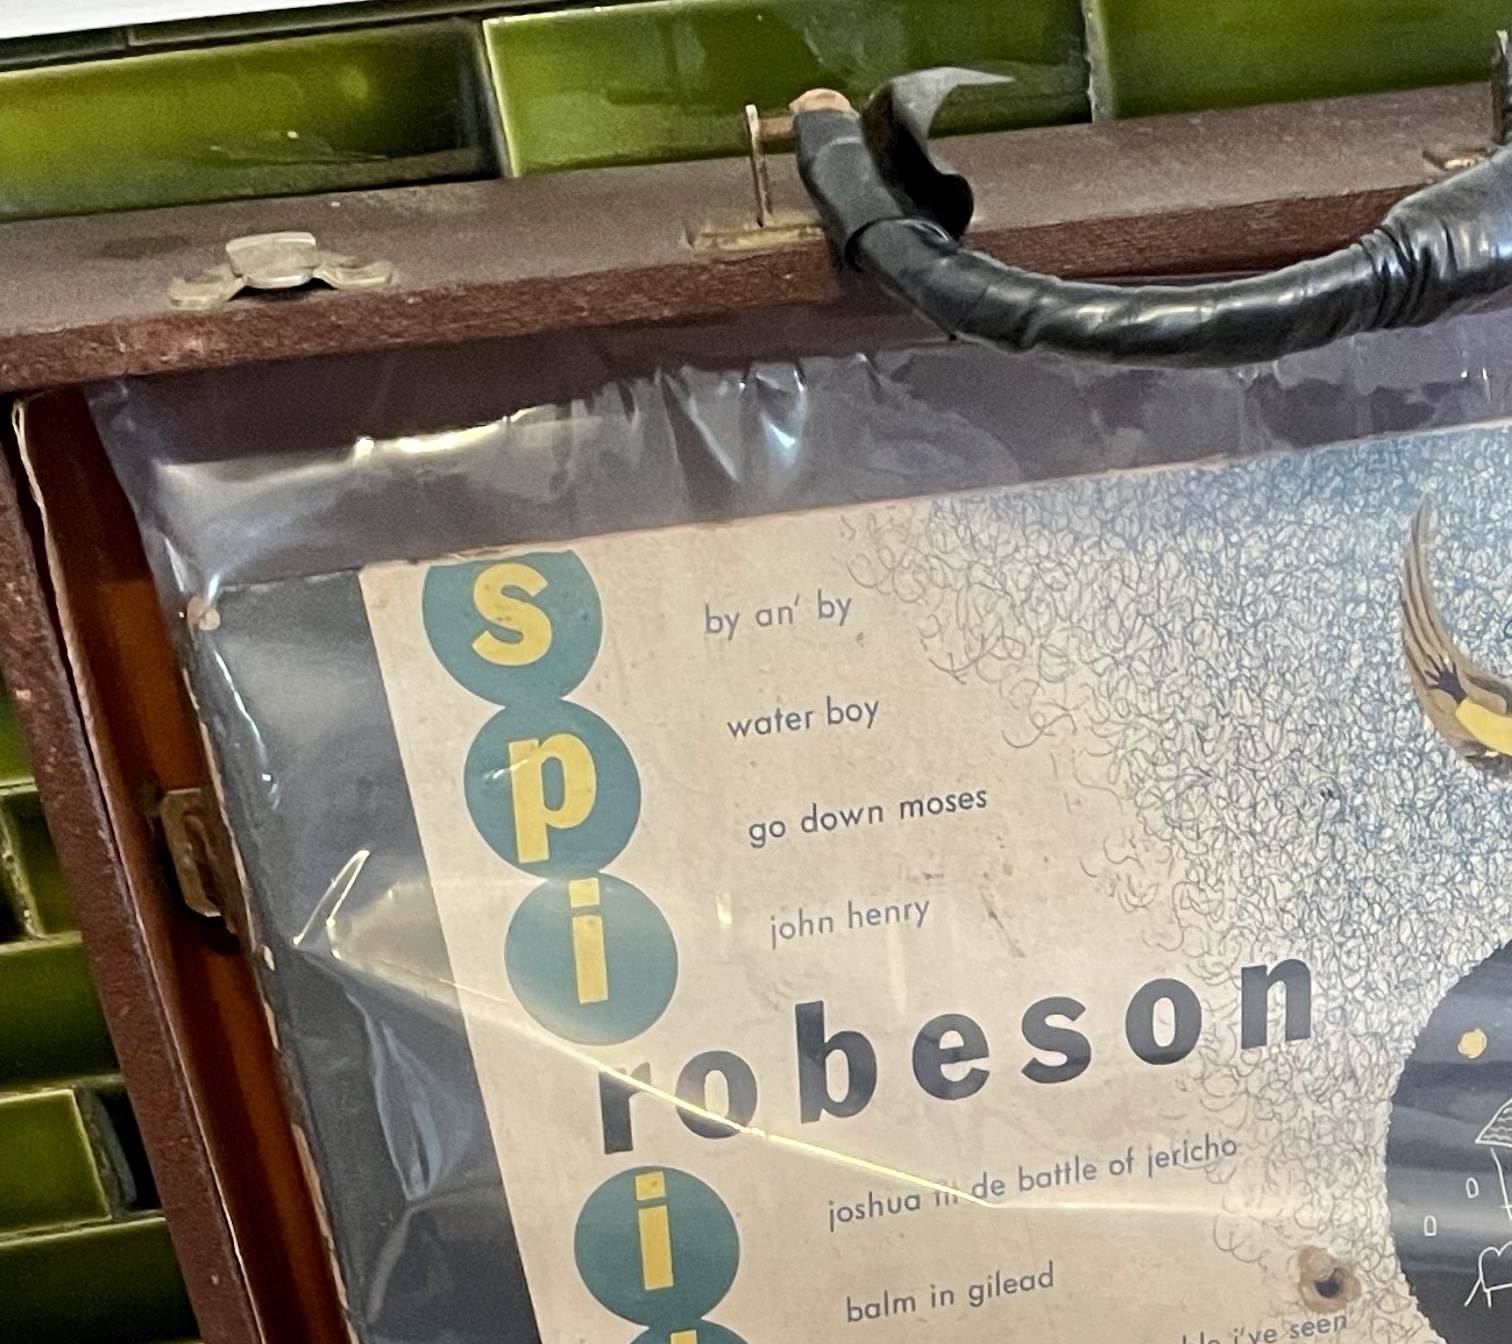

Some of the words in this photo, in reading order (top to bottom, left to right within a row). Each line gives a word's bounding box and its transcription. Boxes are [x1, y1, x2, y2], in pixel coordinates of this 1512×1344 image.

[705, 602, 740, 641] by
[755, 594, 800, 628] an'
[817, 588, 852, 627] by
[727, 707, 814, 739] water
[826, 695, 879, 729] boy
[749, 820, 786, 849] go
[801, 802, 883, 833] down
[900, 789, 987, 819] moses
[770, 915, 834, 950] john
[848, 900, 930, 928] henry
[598, 958, 1312, 1155] robeson
[828, 1191, 921, 1233] joshua
[970, 1171, 1006, 1199] de
[1018, 1154, 1097, 1193] battle
[1108, 1146, 1135, 1177] of
[1146, 1133, 1238, 1178] jericho
[846, 1290, 917, 1323] balm
[930, 1284, 954, 1309] in
[968, 1260, 1055, 1308] gilead
[1289, 1314, 1348, 1342] seen
